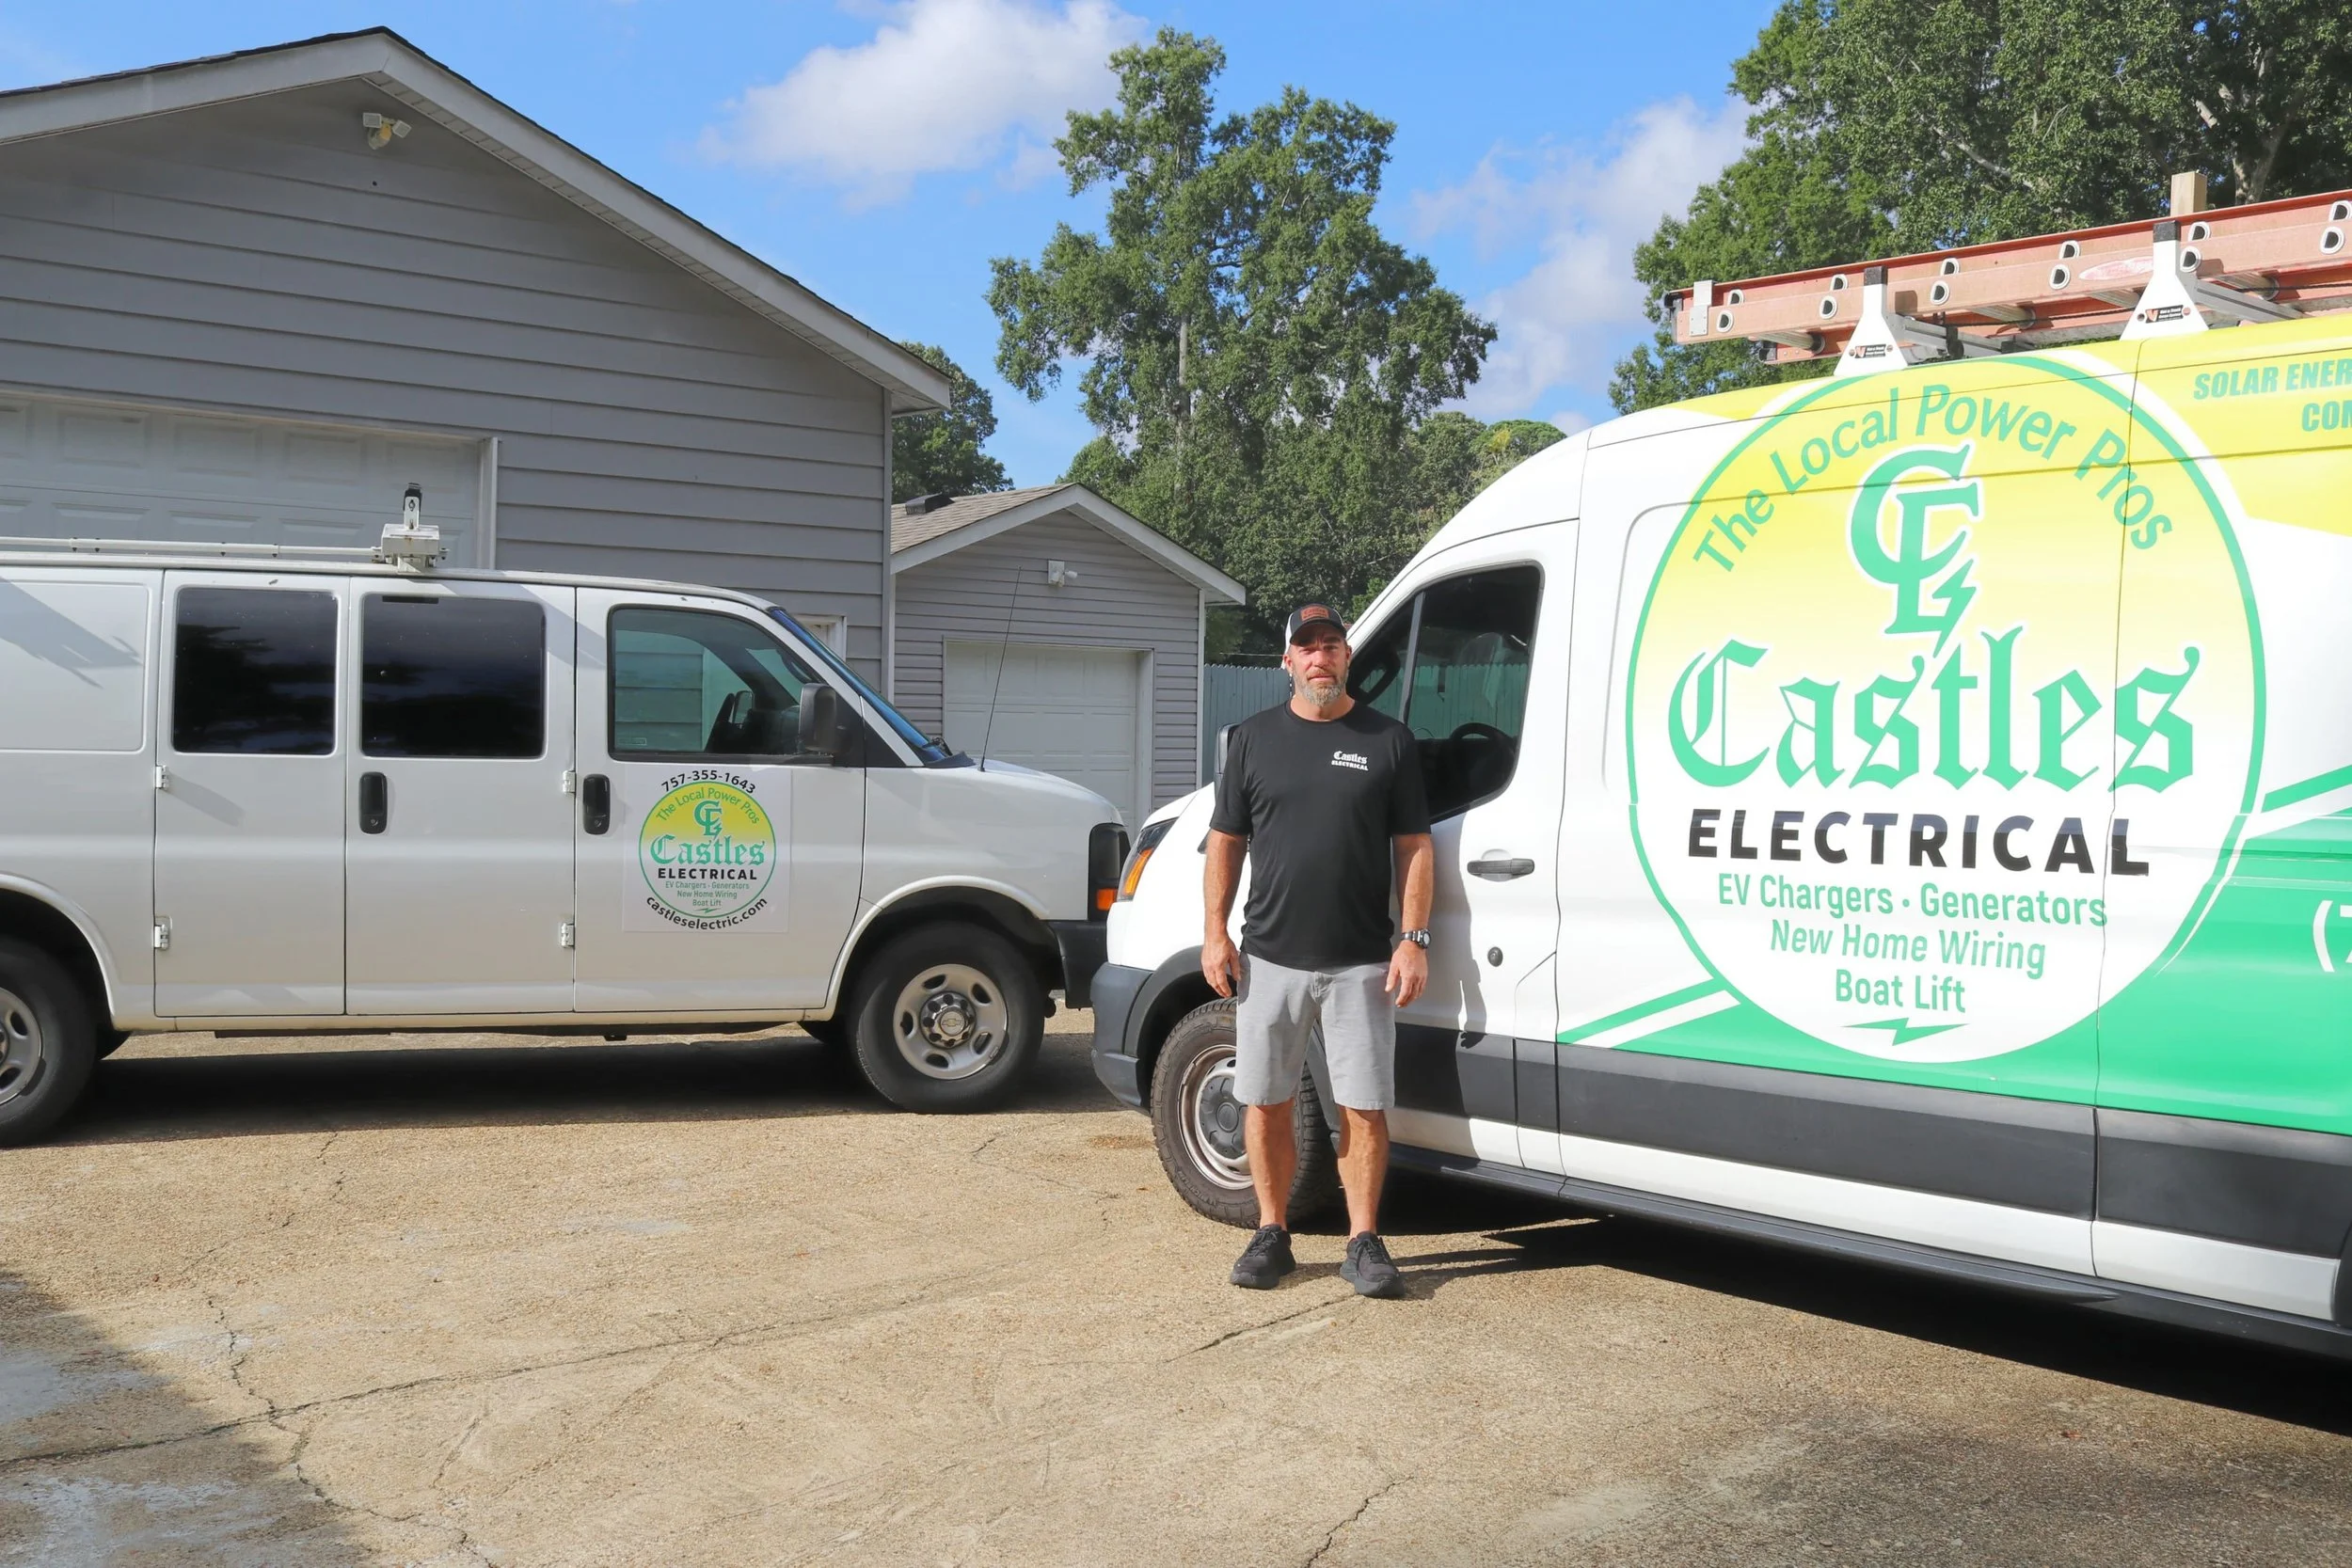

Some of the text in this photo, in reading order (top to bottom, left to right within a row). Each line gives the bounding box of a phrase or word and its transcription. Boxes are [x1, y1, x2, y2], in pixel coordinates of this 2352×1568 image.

[2193, 366, 2279, 400] SOLAR
[1693, 384, 2173, 572] The Local Power Pros
[1668, 626, 2200, 793] Castles
[1331, 759, 1369, 771] ELECTRICAL
[1333, 751, 1367, 764] Castles
[661, 769, 756, 794] 757-355-1643
[656, 787, 760, 824] The Local Power Pros
[650, 834, 766, 865] Castles
[1688, 808, 2150, 876] ELECTRICAL
[658, 868, 757, 880] ELECTRICAL
[675, 881, 707, 891] Chargers
[646, 895, 768, 930] castleselectric.com
[715, 891, 738, 900] Wiring
[1719, 873, 2108, 927] EV Chargers Generators
[1770, 920, 2046, 980] New Home Wiring
[1836, 969, 1966, 1014] Boat Lift
